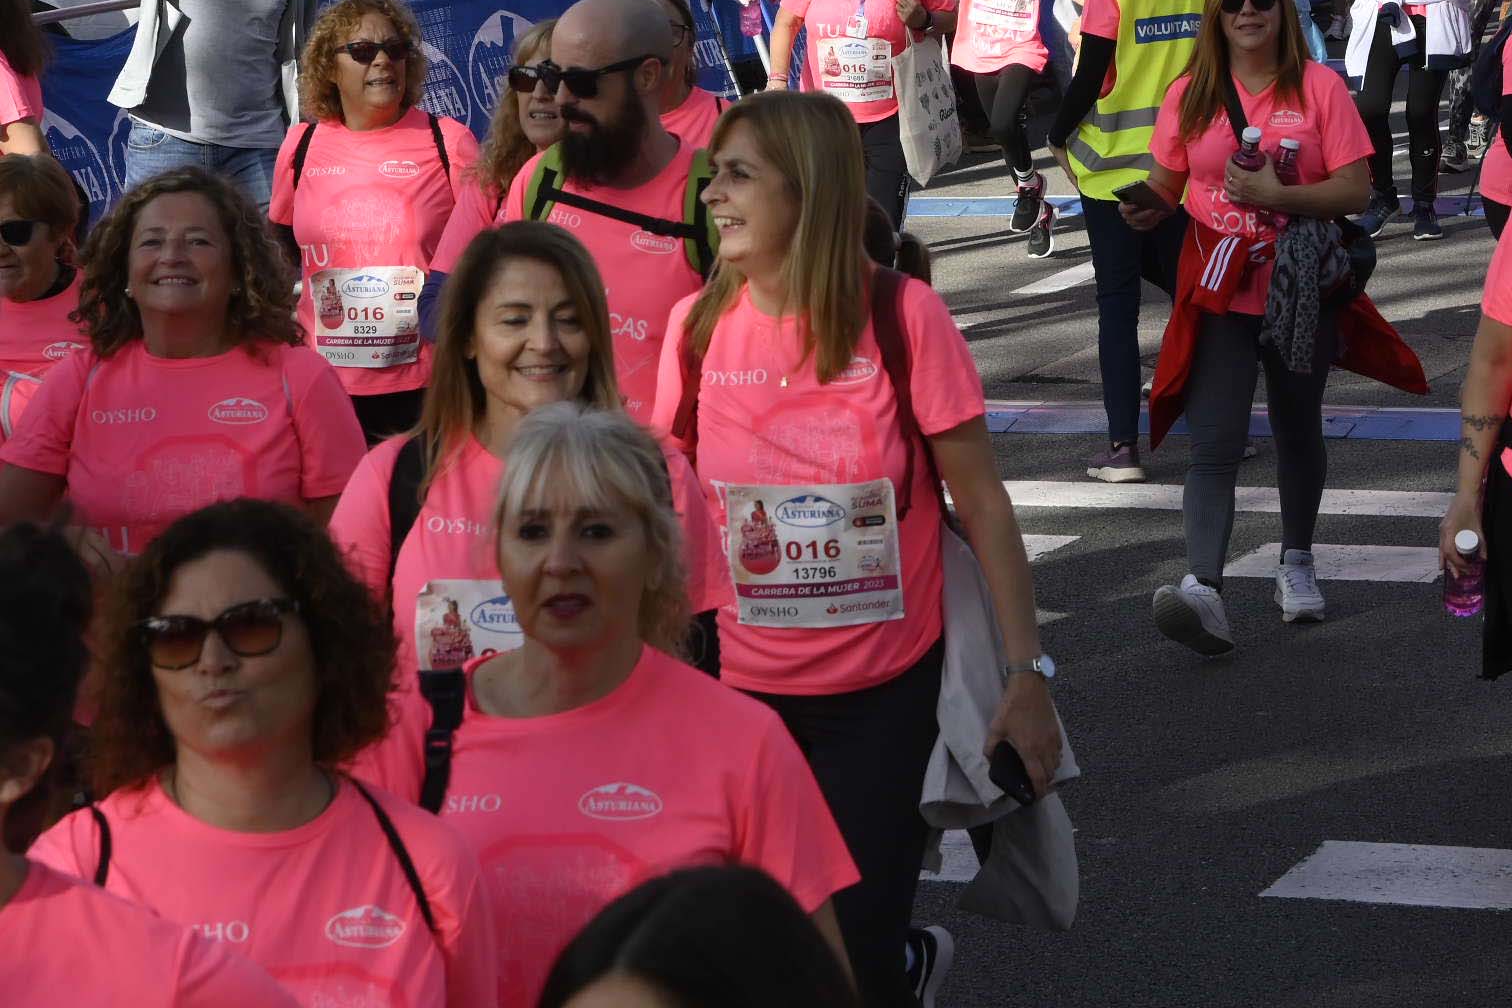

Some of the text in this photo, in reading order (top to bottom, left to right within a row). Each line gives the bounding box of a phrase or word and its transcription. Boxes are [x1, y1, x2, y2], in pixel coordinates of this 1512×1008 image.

[816, 23, 841, 38] TU
[842, 63, 867, 73] 016
[306, 165, 346, 178] OYSHO
[301, 242, 330, 268] TU
[344, 282, 386, 293] ASTURIANA
[347, 306, 385, 321] 016
[353, 325, 378, 335] 8329
[703, 368, 768, 386] OYSHO
[91, 406, 157, 426] OYSHO
[213, 406, 265, 420] ASTURIANA
[780, 506, 842, 521] ASTURIANA
[785, 538, 842, 562] 016
[792, 565, 838, 581] 13796
[751, 586, 798, 596] CARRERA
[798, 586, 813, 595] DE
[812, 585, 826, 595] LA
[827, 582, 860, 594] MUJER
[750, 605, 799, 619] OYSHO
[840, 598, 891, 614] Santander
[585, 793, 658, 815] ASTURIANA
